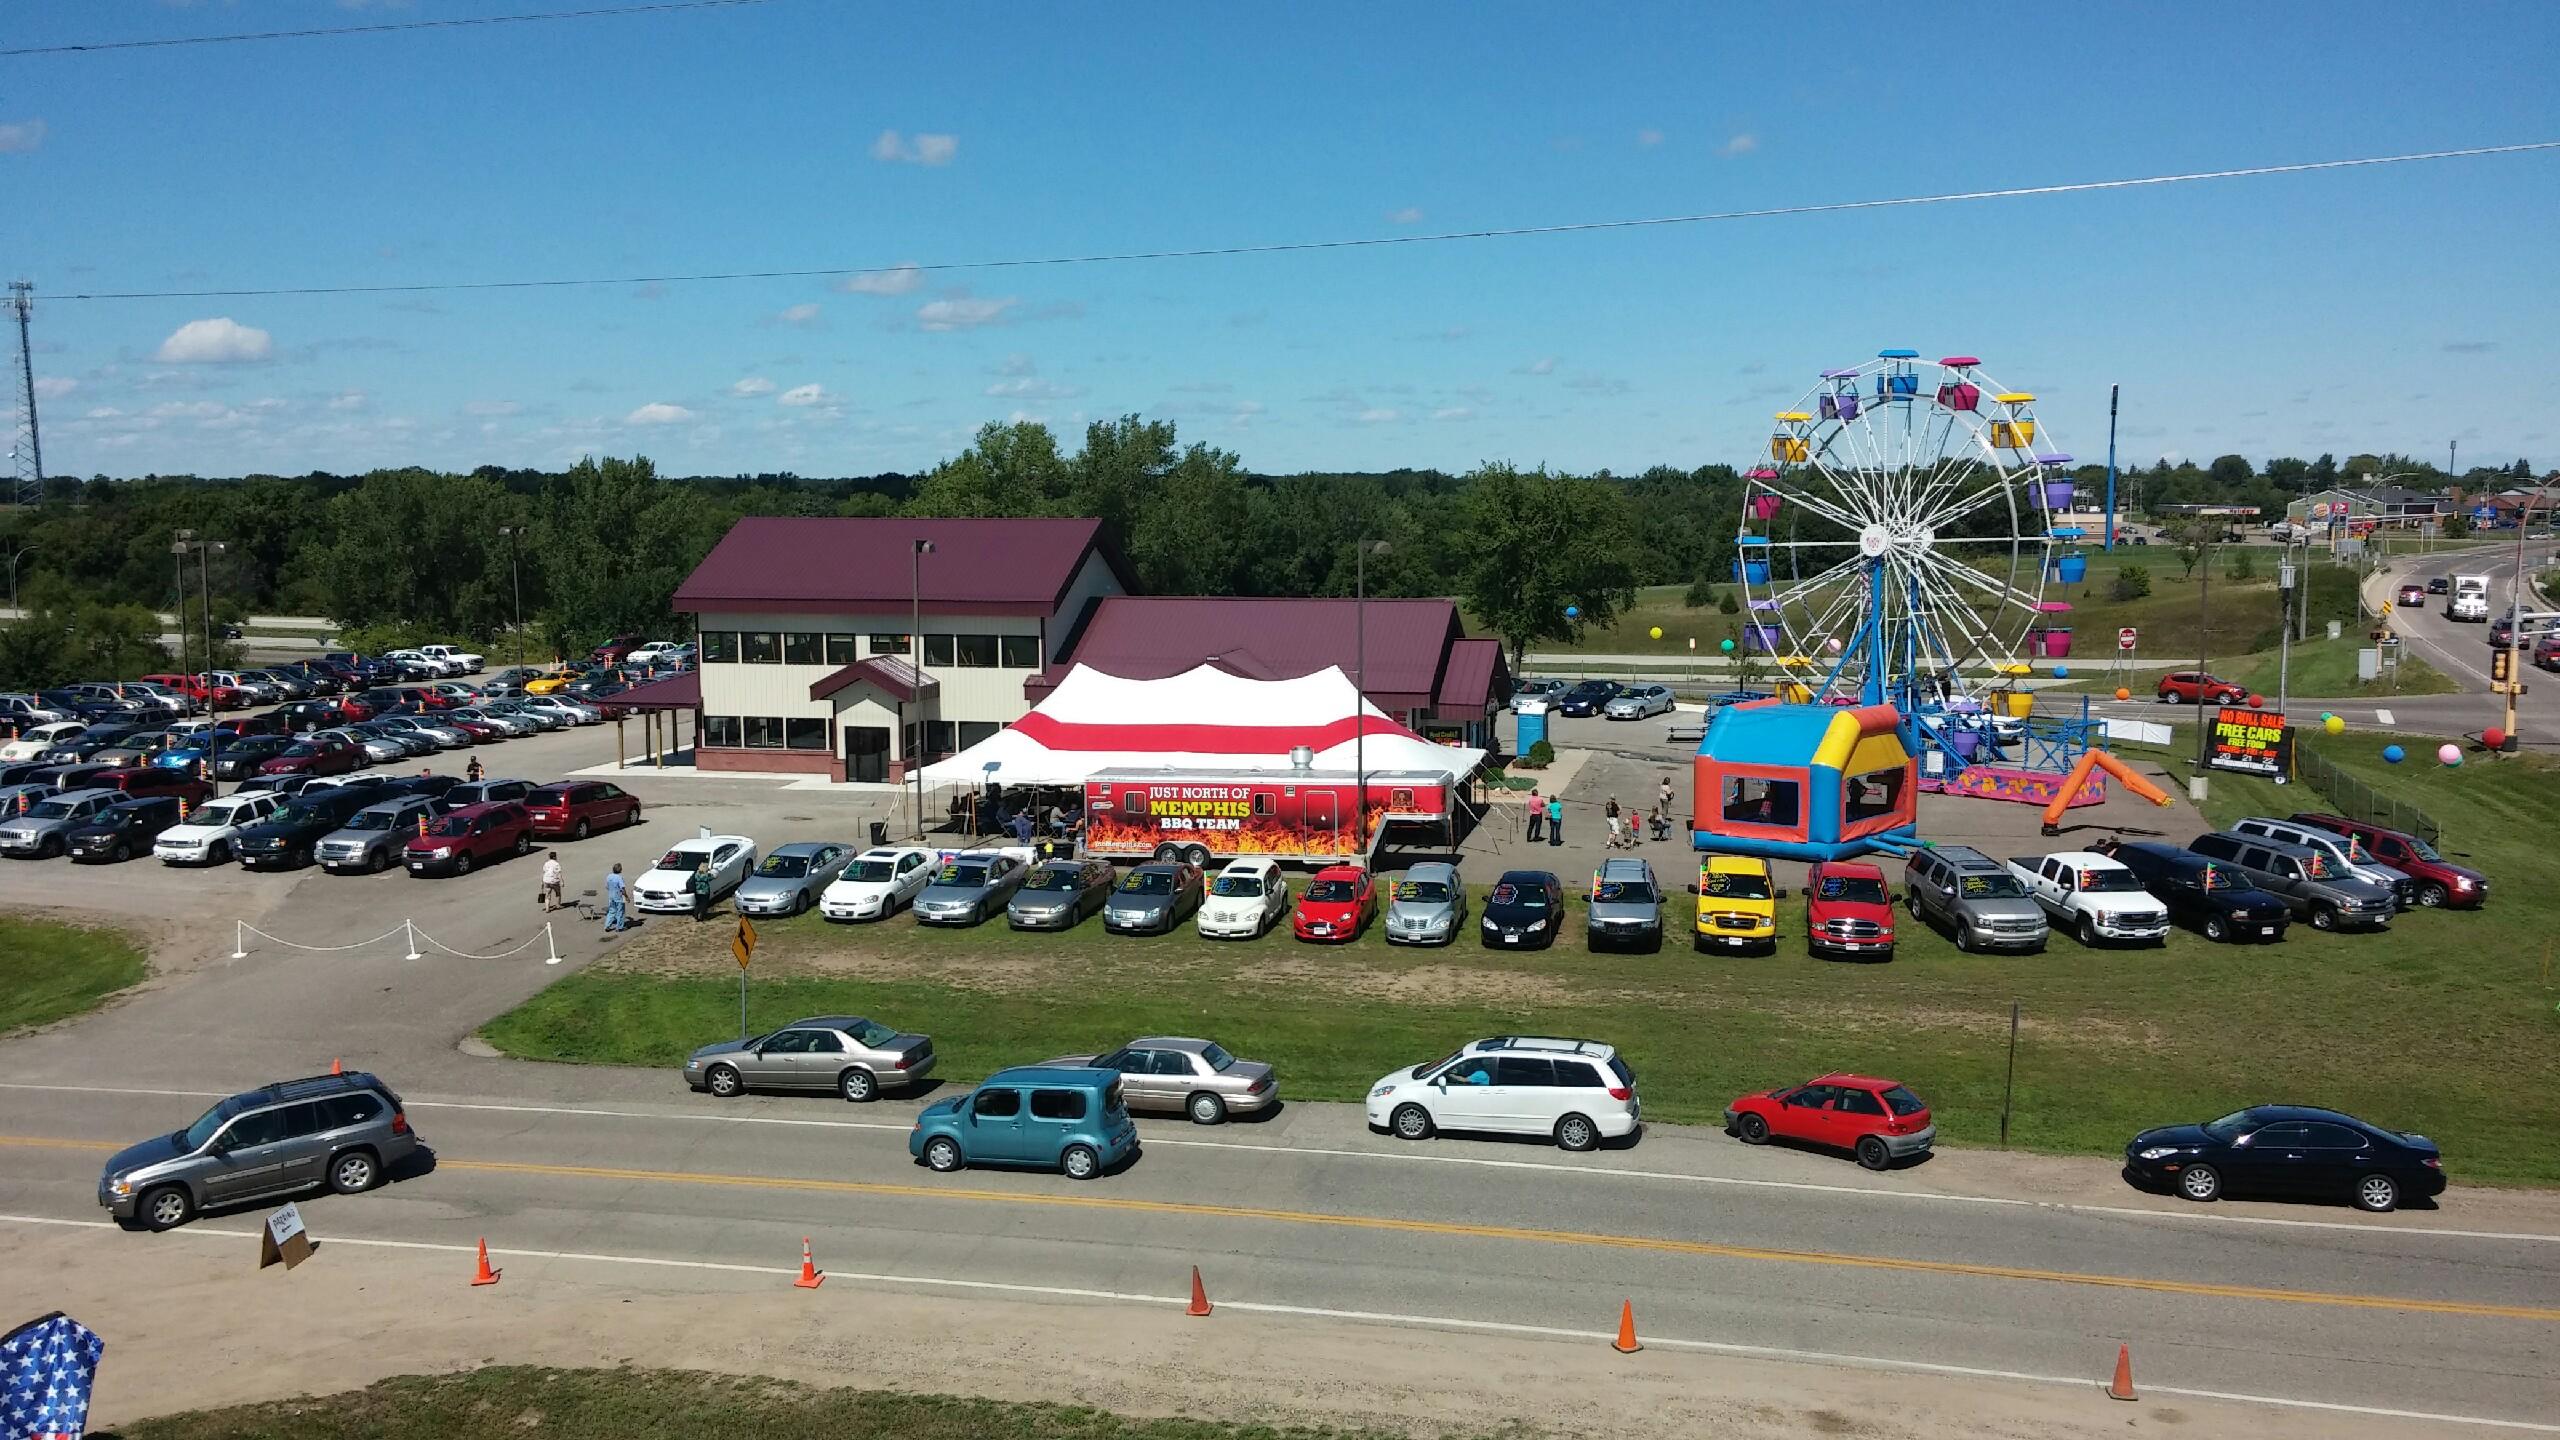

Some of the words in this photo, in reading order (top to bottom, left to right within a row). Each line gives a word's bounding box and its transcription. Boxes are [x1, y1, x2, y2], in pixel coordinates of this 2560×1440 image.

[2220, 710, 2234, 722] NO
[2236, 711, 2259, 726] BULL
[2261, 713, 2285, 729] SALE
[2216, 722, 2247, 738] FREE
[2247, 726, 2281, 742] CARS
[2228, 738, 2246, 747] FREE
[2246, 740, 2266, 749] FOOD
[2219, 752, 2231, 760] 20
[2242, 754, 2252, 762] 21
[1150, 787, 1179, 799] JUST
[1182, 787, 1229, 799] NORTH
[1231, 787, 1251, 799] OF
[1150, 801, 1251, 817] MEMPHIS
[1161, 817, 1193, 830] BBQ
[1197, 818, 1240, 830] TEAM
